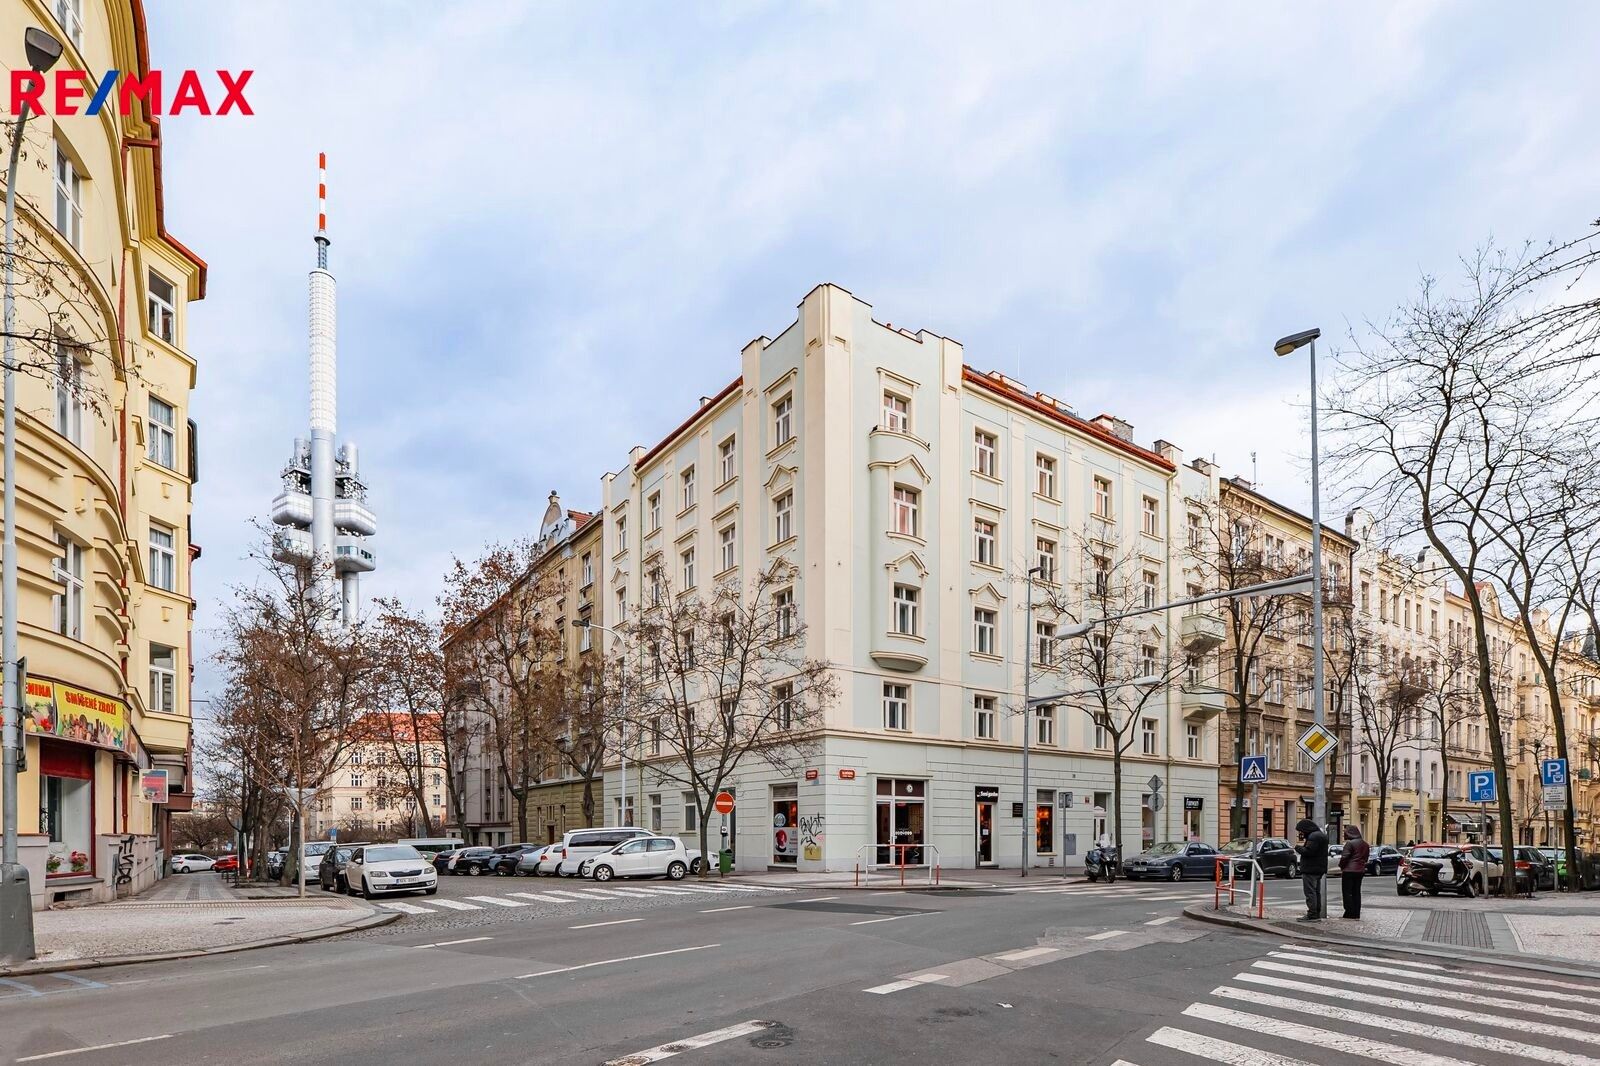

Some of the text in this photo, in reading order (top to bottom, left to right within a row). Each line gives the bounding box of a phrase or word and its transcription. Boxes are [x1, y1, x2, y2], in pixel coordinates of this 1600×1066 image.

[98, 700, 117, 715] ZBOŽÍ
[1547, 762, 1561, 778] P
[1474, 775, 1490, 793] P
